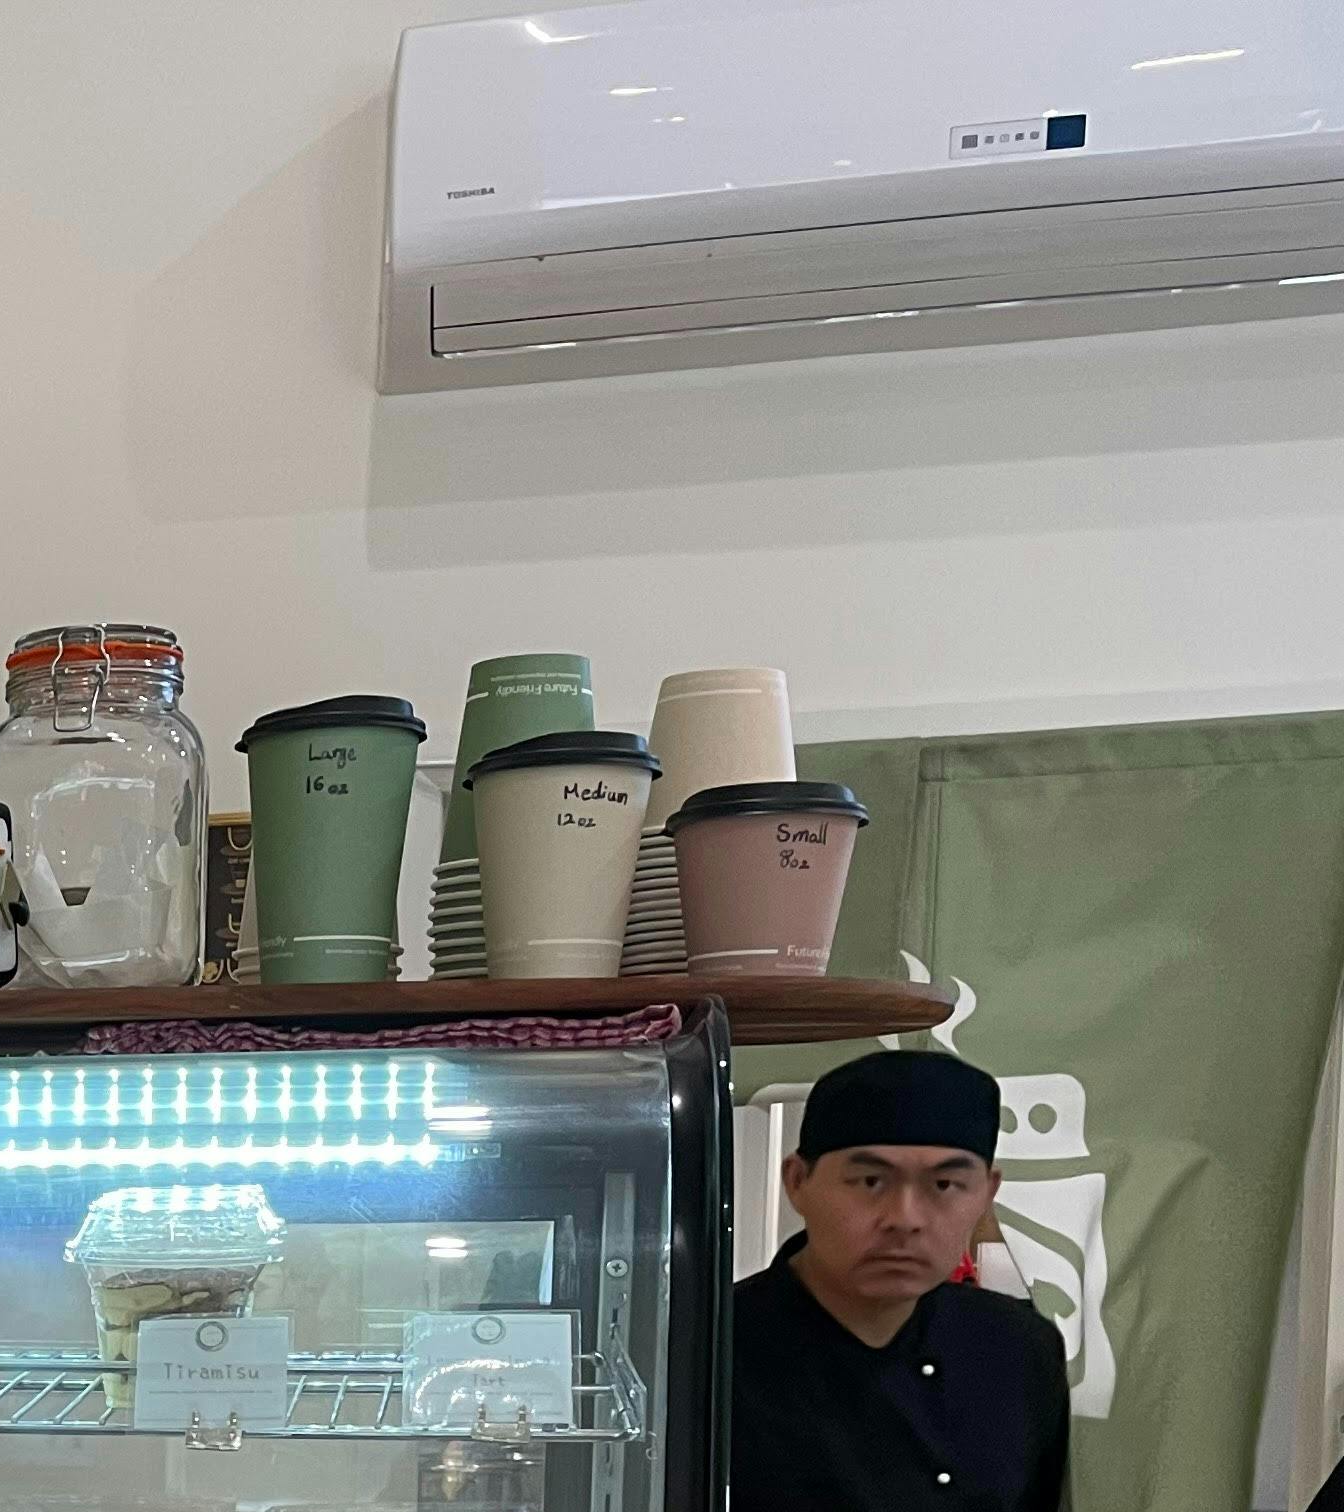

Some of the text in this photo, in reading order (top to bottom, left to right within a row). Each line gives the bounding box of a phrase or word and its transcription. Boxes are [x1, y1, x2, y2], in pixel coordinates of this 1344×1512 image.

[308, 743, 357, 769] Large
[563, 780, 630, 805] Medium
[776, 823, 830, 845] Small
[163, 1362, 261, 1380] Tiramisu
